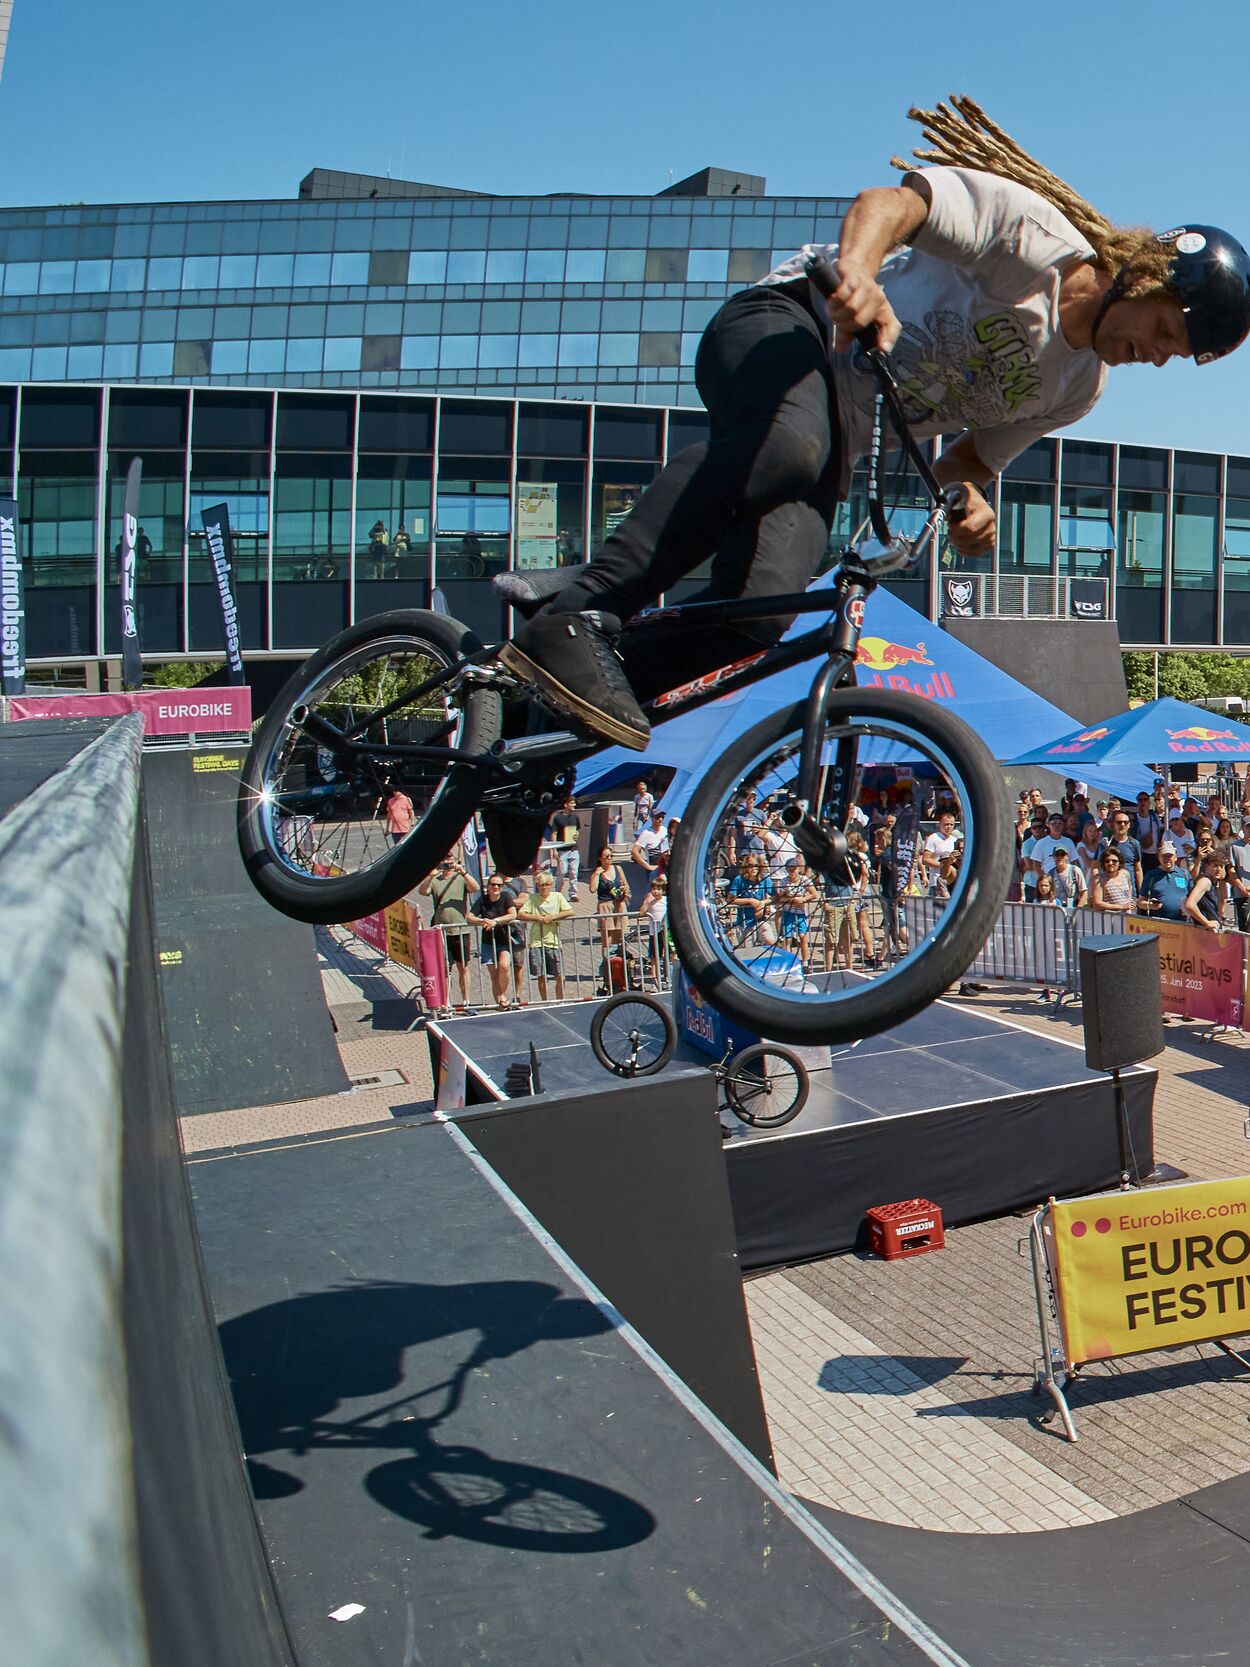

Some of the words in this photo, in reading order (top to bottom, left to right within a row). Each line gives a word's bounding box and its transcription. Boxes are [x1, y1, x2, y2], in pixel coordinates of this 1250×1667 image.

[0, 516, 25, 679] freedombmx
[159, 703, 233, 718] EUROBIKE
[1168, 742, 1209, 753] Red
[160, 950, 182, 961] AYS
[1160, 952, 1196, 976] stival
[1200, 958, 1233, 988] Days
[1185, 979, 1203, 991] 2023
[1119, 1201, 1247, 1231] Eurobike.com
